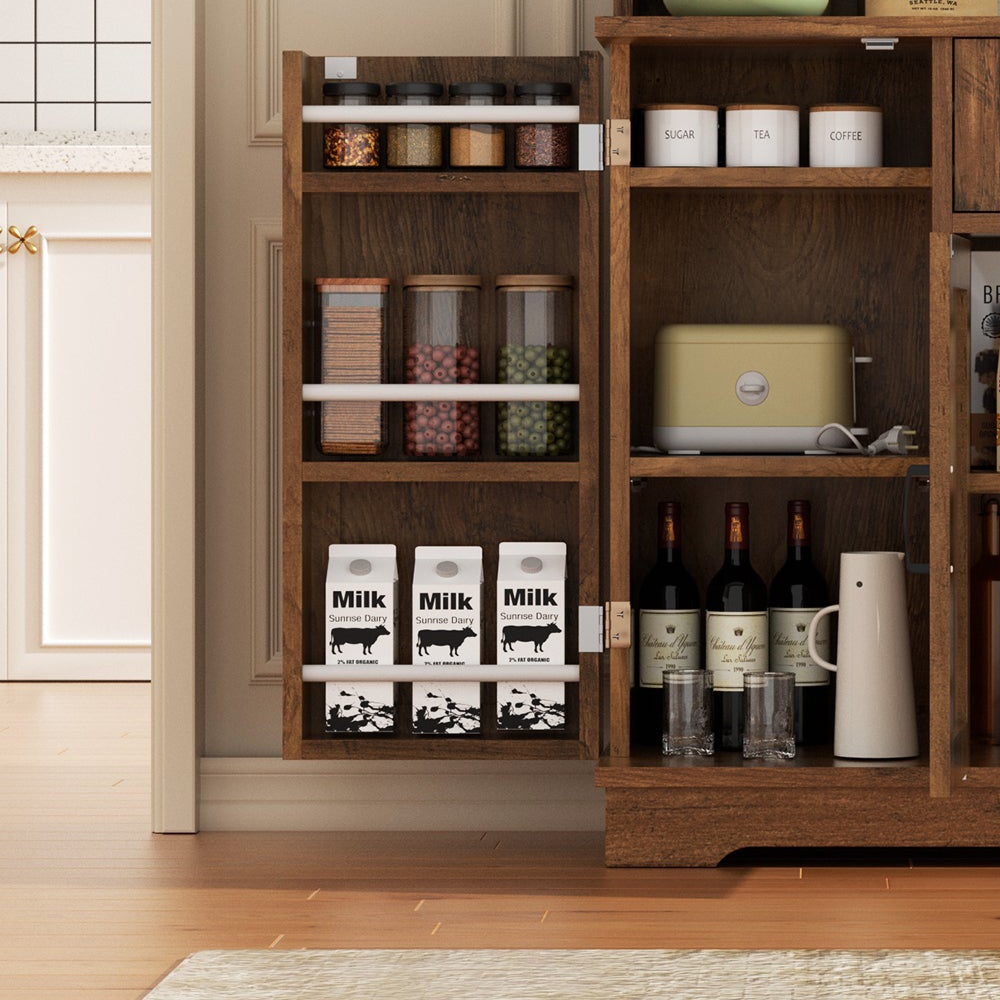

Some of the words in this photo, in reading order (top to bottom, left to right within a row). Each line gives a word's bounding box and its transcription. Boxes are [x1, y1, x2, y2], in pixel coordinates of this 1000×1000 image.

[664, 130, 695, 139] SUGAR
[753, 130, 770, 139] TEA
[830, 131, 862, 141] COFFEE
[332, 591, 386, 608] Milk
[420, 593, 473, 610] Milk
[504, 589, 558, 606] Milk
[329, 615, 362, 623] Sunrise
[364, 615, 388, 624] Dairy
[416, 616, 448, 624] Sunrise
[451, 616, 474, 625] Dairy
[500, 612, 533, 621] Sunrise
[536, 612, 559, 622] Dairy
